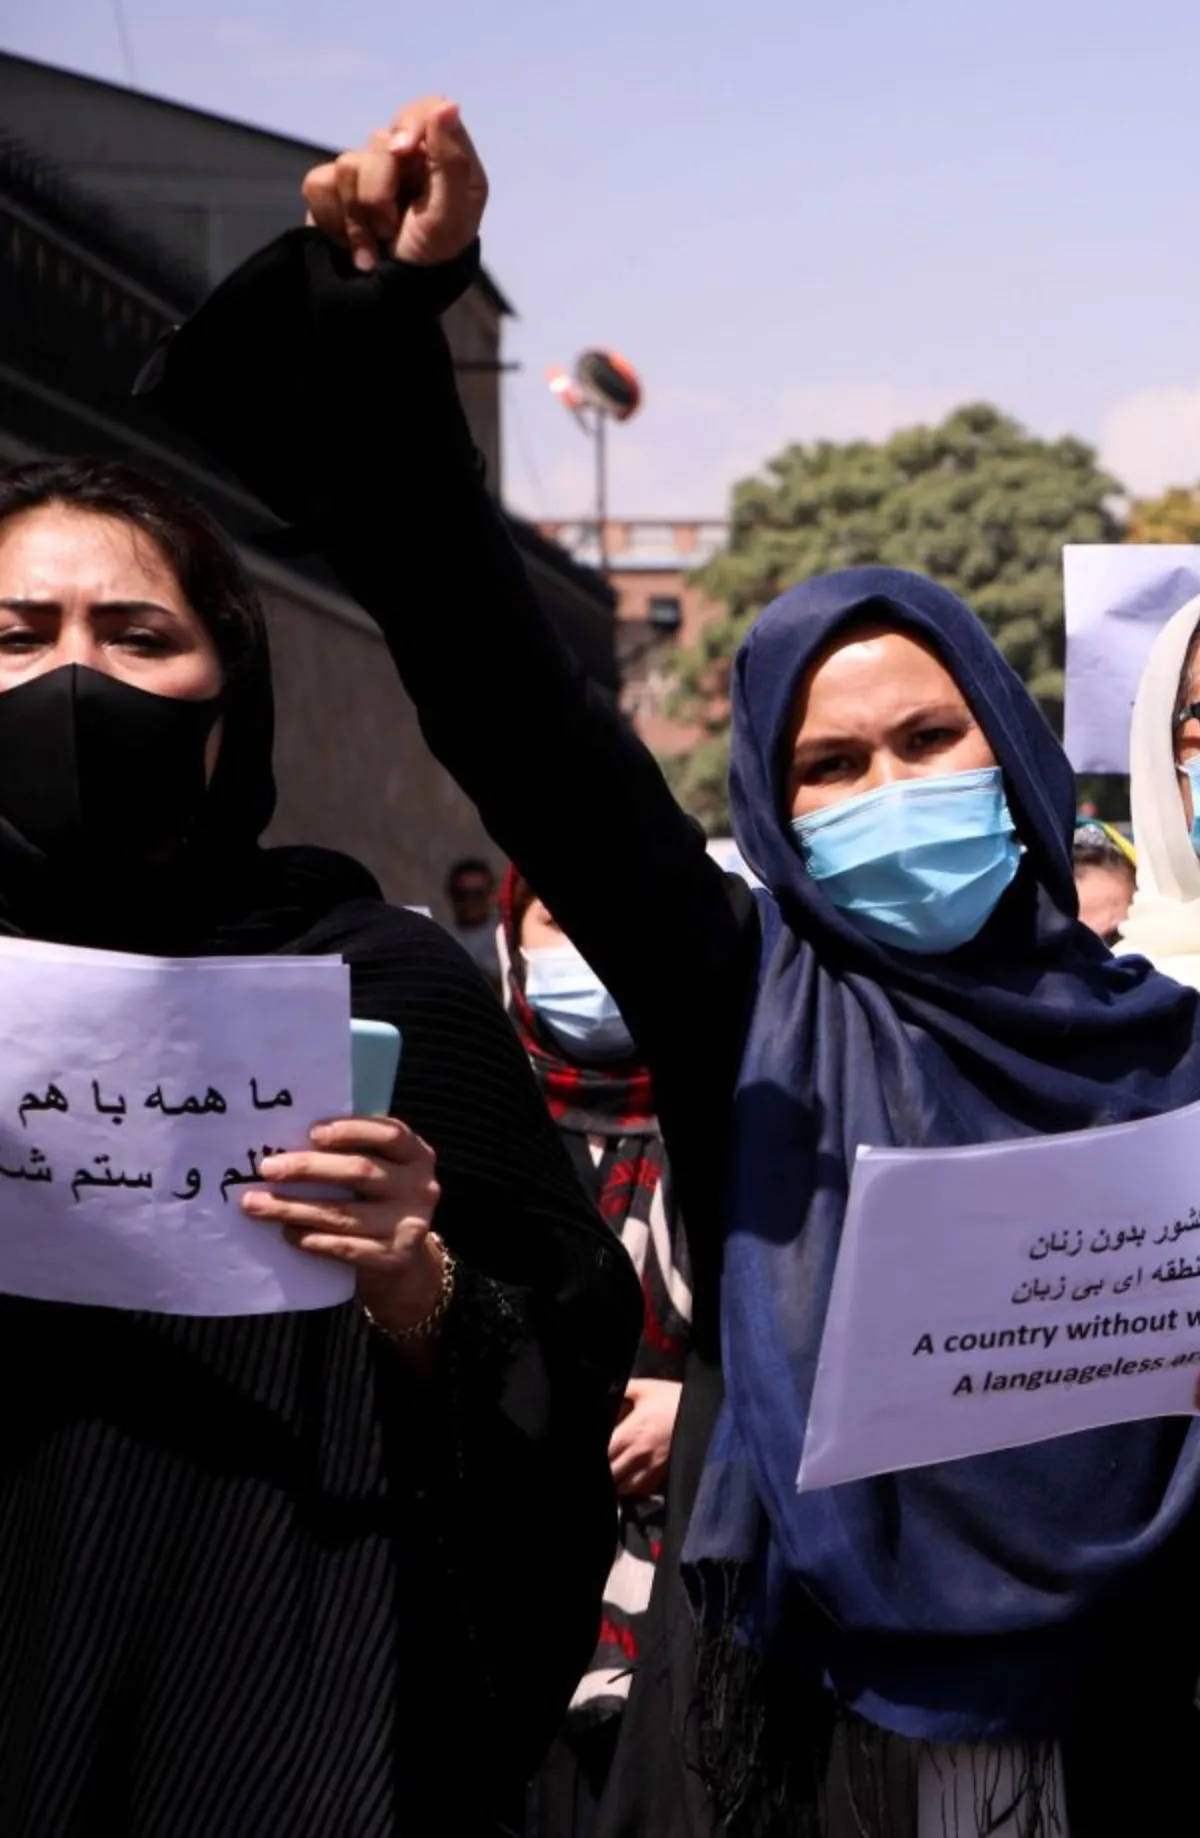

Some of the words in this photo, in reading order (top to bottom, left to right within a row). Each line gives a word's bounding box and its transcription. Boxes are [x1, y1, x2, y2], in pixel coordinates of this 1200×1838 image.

[18, 1082, 69, 1129] هم
[92, 1079, 126, 1126] با
[144, 1084, 228, 1117] همه
[249, 1077, 294, 1110] ما
[71, 1154, 153, 1203] ستم
[172, 1171, 202, 1200] و
[1029, 1230, 1084, 1260] زنان
[1090, 1225, 1147, 1253] بدون
[1011, 1275, 1066, 1304] زبان
[1071, 1277, 1104, 1301] بی
[1113, 1266, 1143, 1294] ای
[912, 1333, 936, 1357] A
[943, 1321, 1060, 1356] country
[1066, 1308, 1178, 1342] without
[952, 1374, 974, 1396] A
[982, 1354, 1165, 1394] languageless
